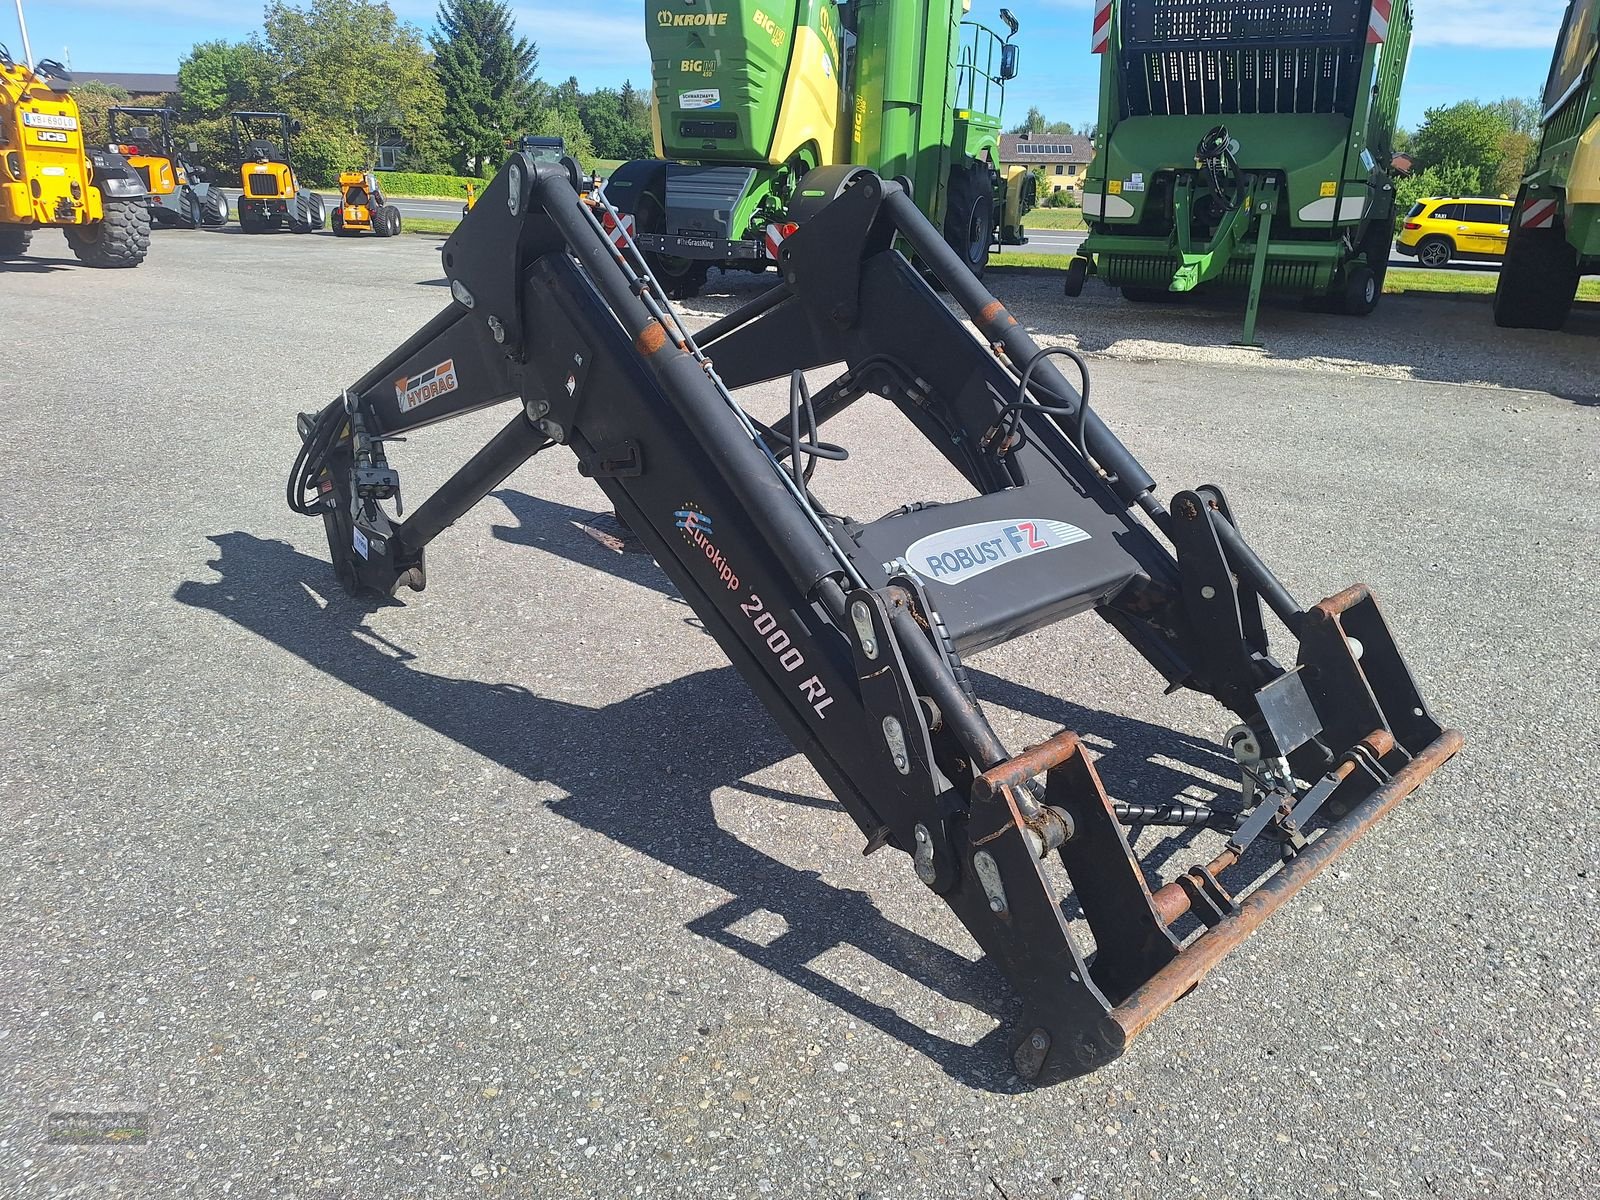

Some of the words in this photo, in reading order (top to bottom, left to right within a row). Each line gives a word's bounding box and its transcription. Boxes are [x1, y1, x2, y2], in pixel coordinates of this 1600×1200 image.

[673, 13, 728, 26] KRONE
[38, 132, 67, 142] JCB
[407, 374, 455, 408] HYDRAC
[925, 538, 1007, 577] ROBUST
[1002, 521, 1049, 553] FZ
[684, 511, 741, 592] Eurokipp
[740, 593, 805, 673] 2000
[798, 675, 834, 720] RL
